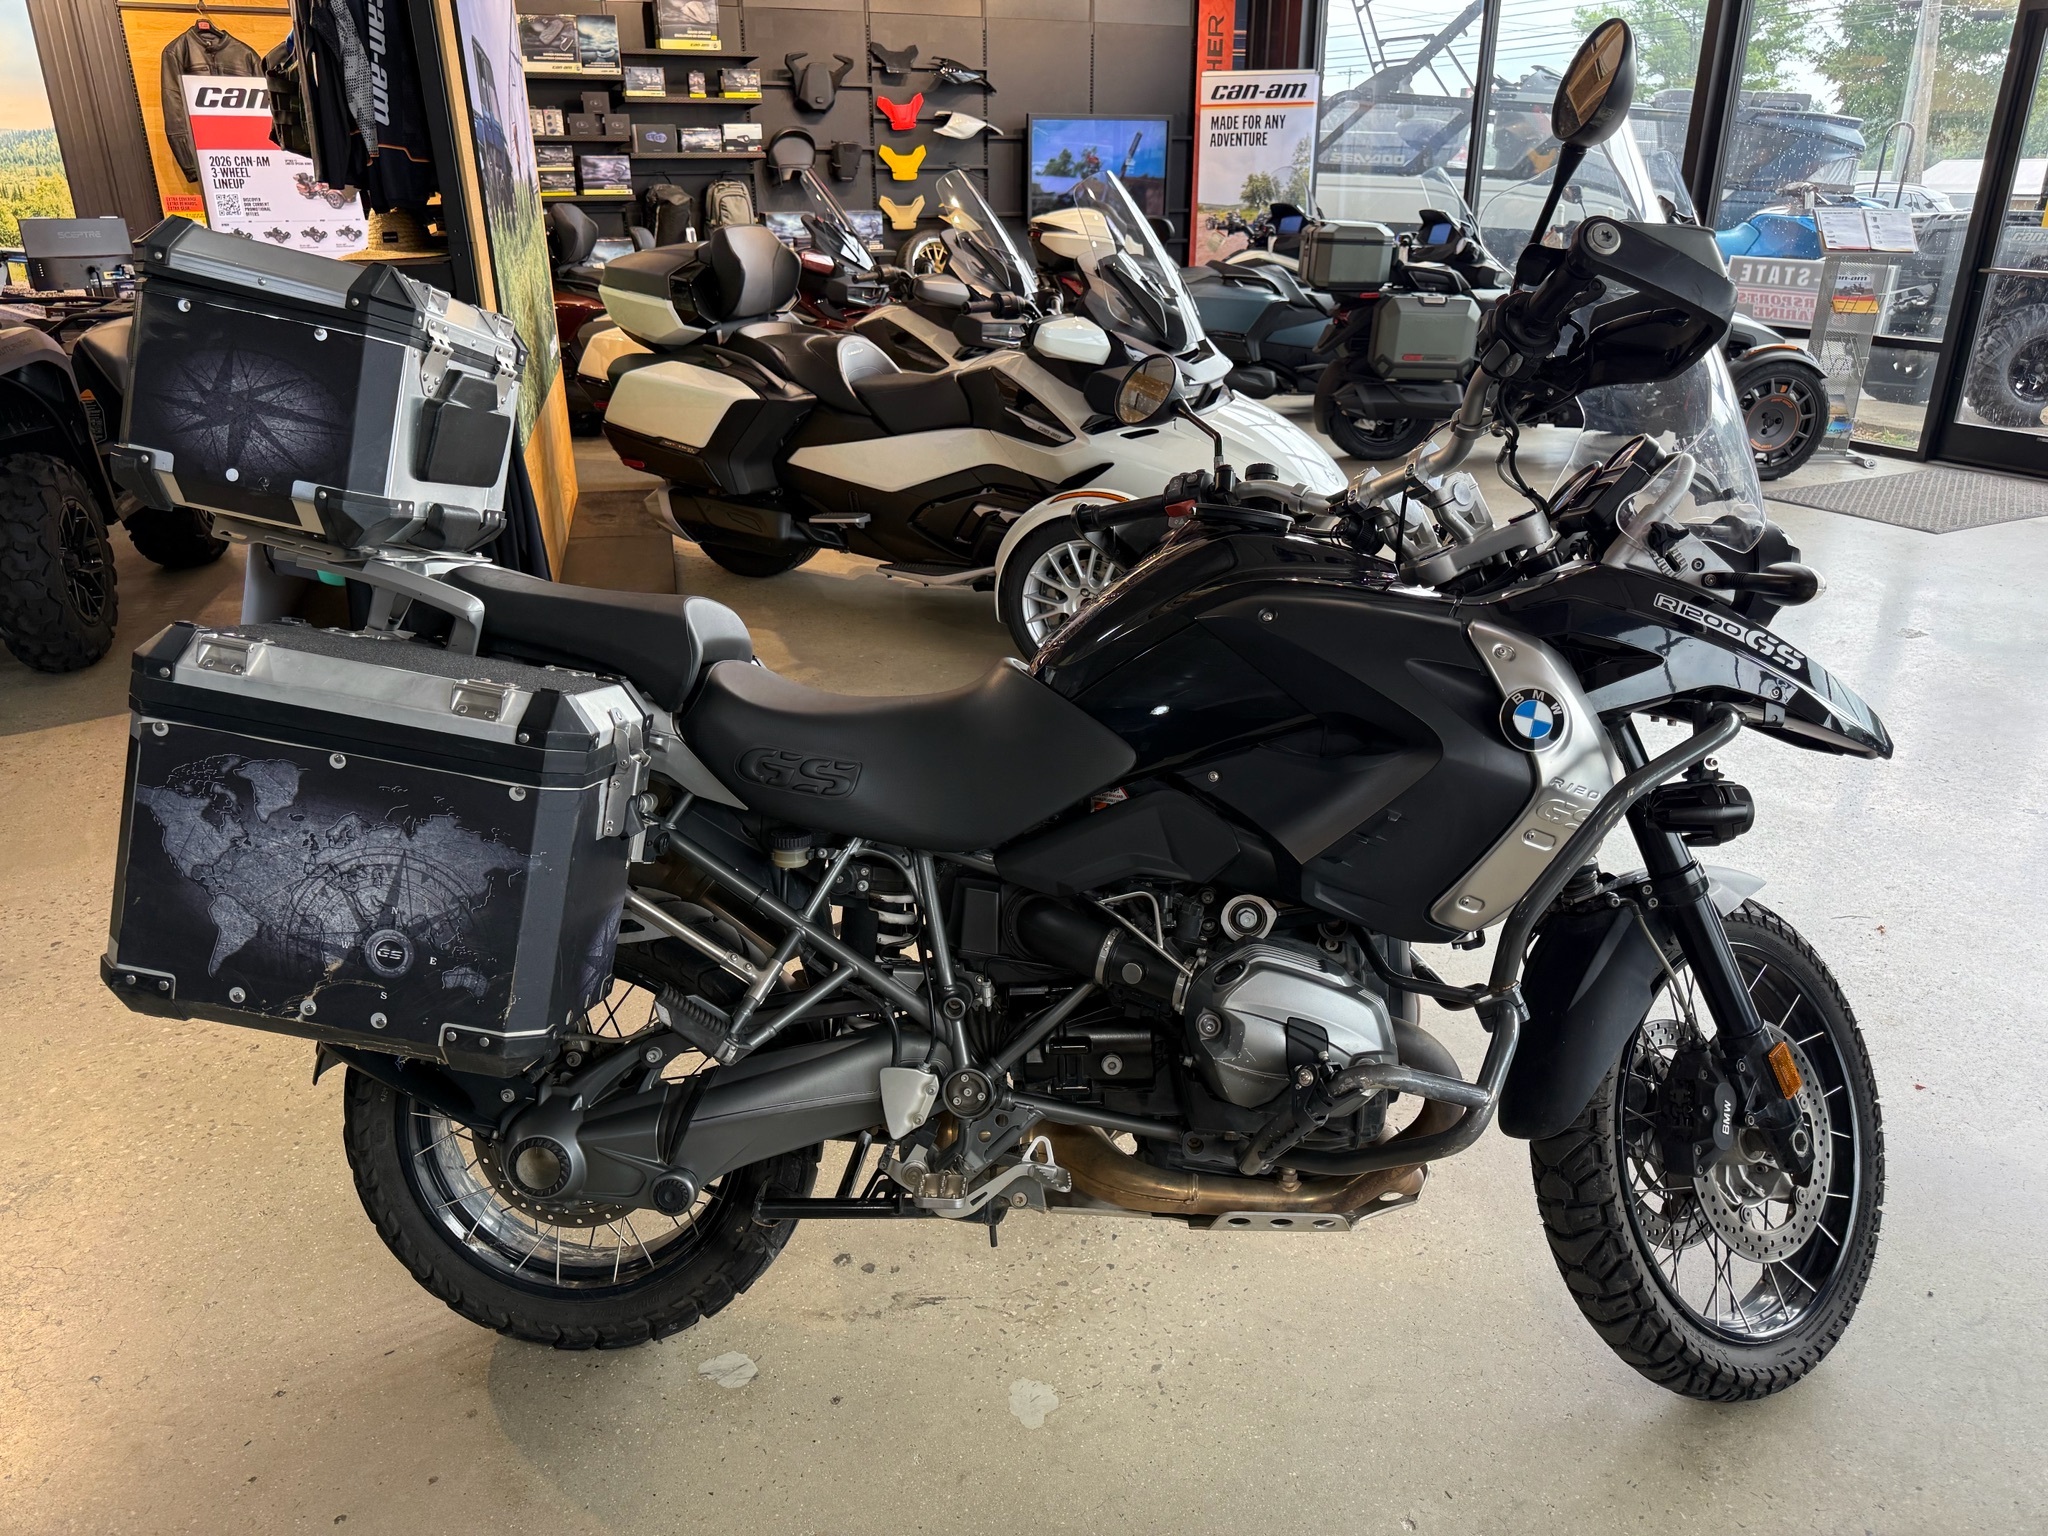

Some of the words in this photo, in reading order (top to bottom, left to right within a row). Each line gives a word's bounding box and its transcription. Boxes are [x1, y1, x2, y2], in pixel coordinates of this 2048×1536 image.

[368, 0, 390, 126] an-am
[1211, 83, 1308, 100] can-am
[1210, 116, 1239, 130] MADE
[1242, 115, 1261, 129] FOR
[1265, 115, 1287, 129] ANY
[1209, 132, 1269, 147] ADVENTURE
[209, 156, 232, 167] 2026
[234, 156, 271, 167] CAN-AM
[212, 167, 251, 178] 3-WHEEL
[213, 178, 246, 190] LINEUP
[57, 231, 102, 239] SCEPTRE
[2012, 232, 2048, 242] can-
[1038, 426, 1061, 440] can-am
[1511, 690, 1563, 716] BMW
[738, 747, 858, 797] GS
[1550, 777, 1600, 801] R120
[341, 940, 351, 949] W
[376, 948, 403, 960] GS
[429, 956, 438, 966] E
[380, 991, 388, 1000] S
[1722, 1099, 1732, 1135] BMW
